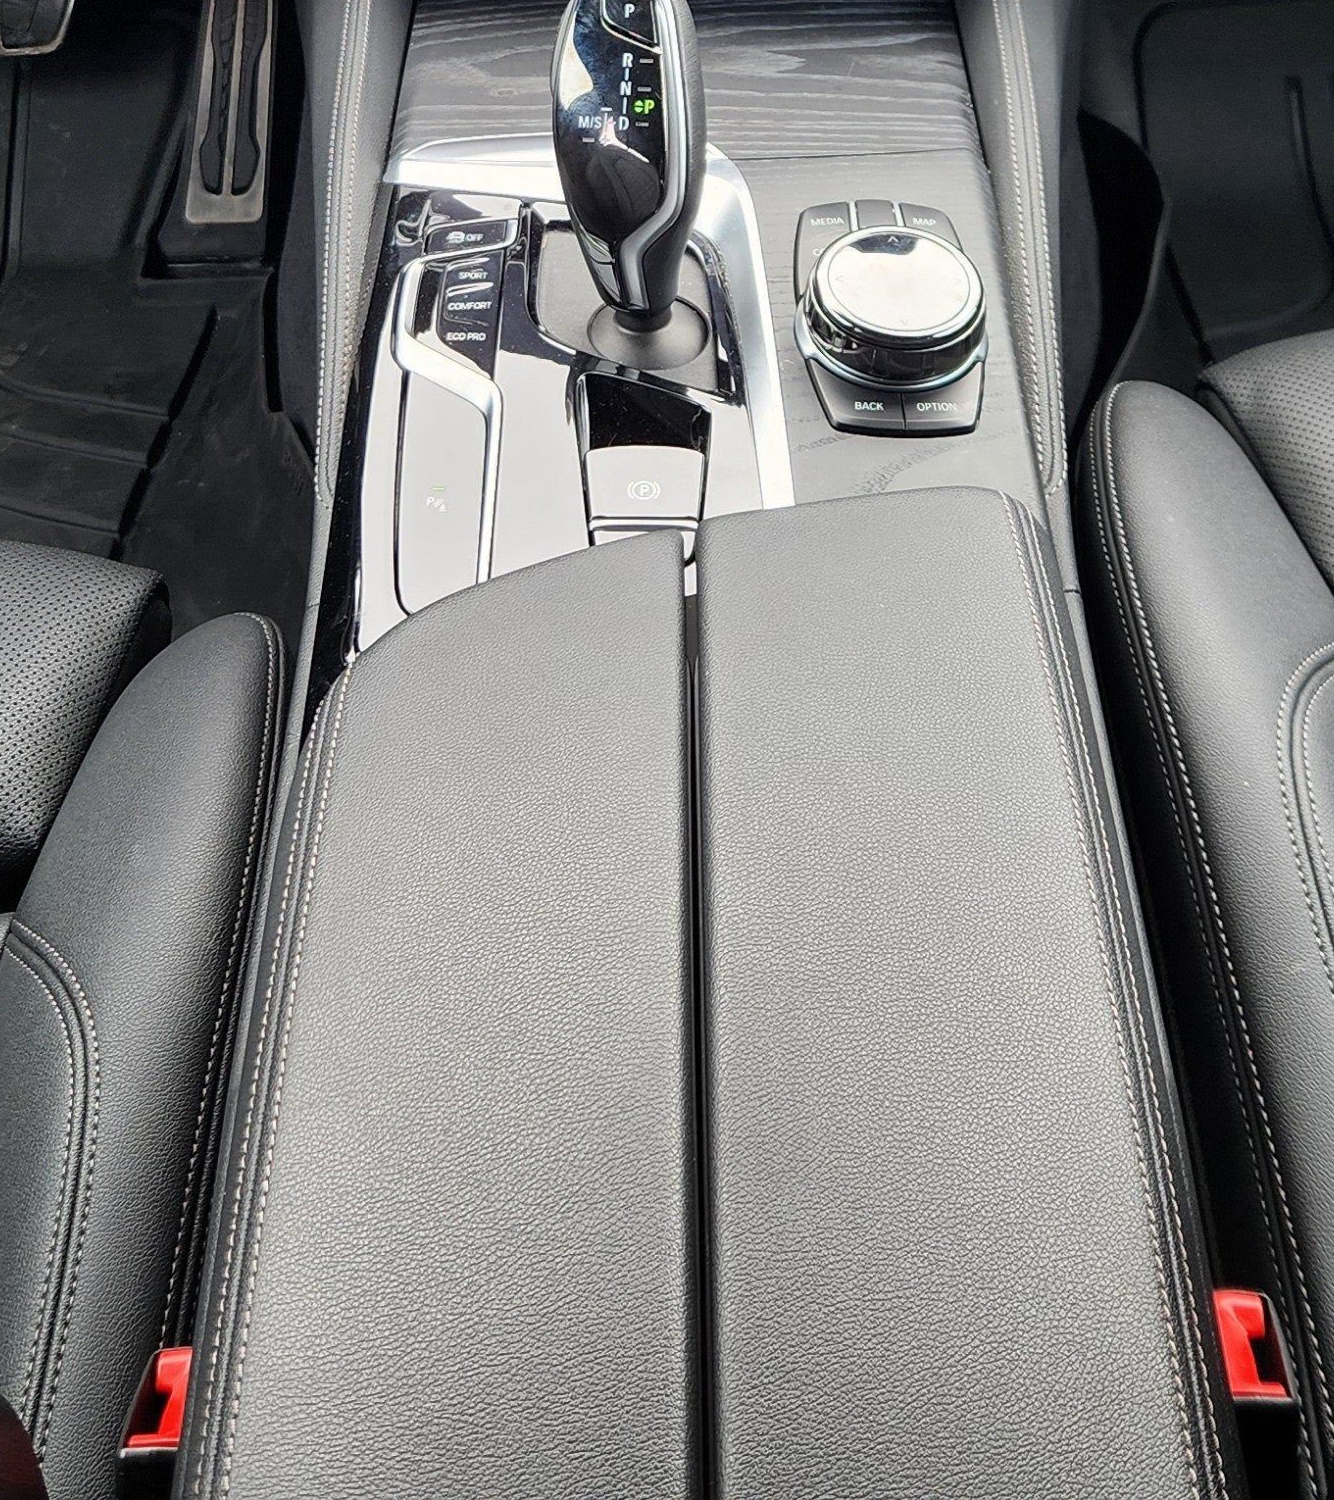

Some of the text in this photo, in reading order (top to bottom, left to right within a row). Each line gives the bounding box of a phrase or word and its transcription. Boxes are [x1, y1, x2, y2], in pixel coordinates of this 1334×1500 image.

[624, 3, 635, 18] P
[622, 52, 634, 68] R
[620, 81, 632, 96] N
[578, 115, 629, 131] M/S D
[810, 216, 845, 227] MEDIA
[912, 216, 936, 227] MAP
[458, 271, 488, 280] SPORT
[447, 301, 492, 311] COMFORT
[445, 331, 486, 341] ECO PRO
[854, 401, 884, 412] BACK
[916, 401, 957, 412] OPTION
